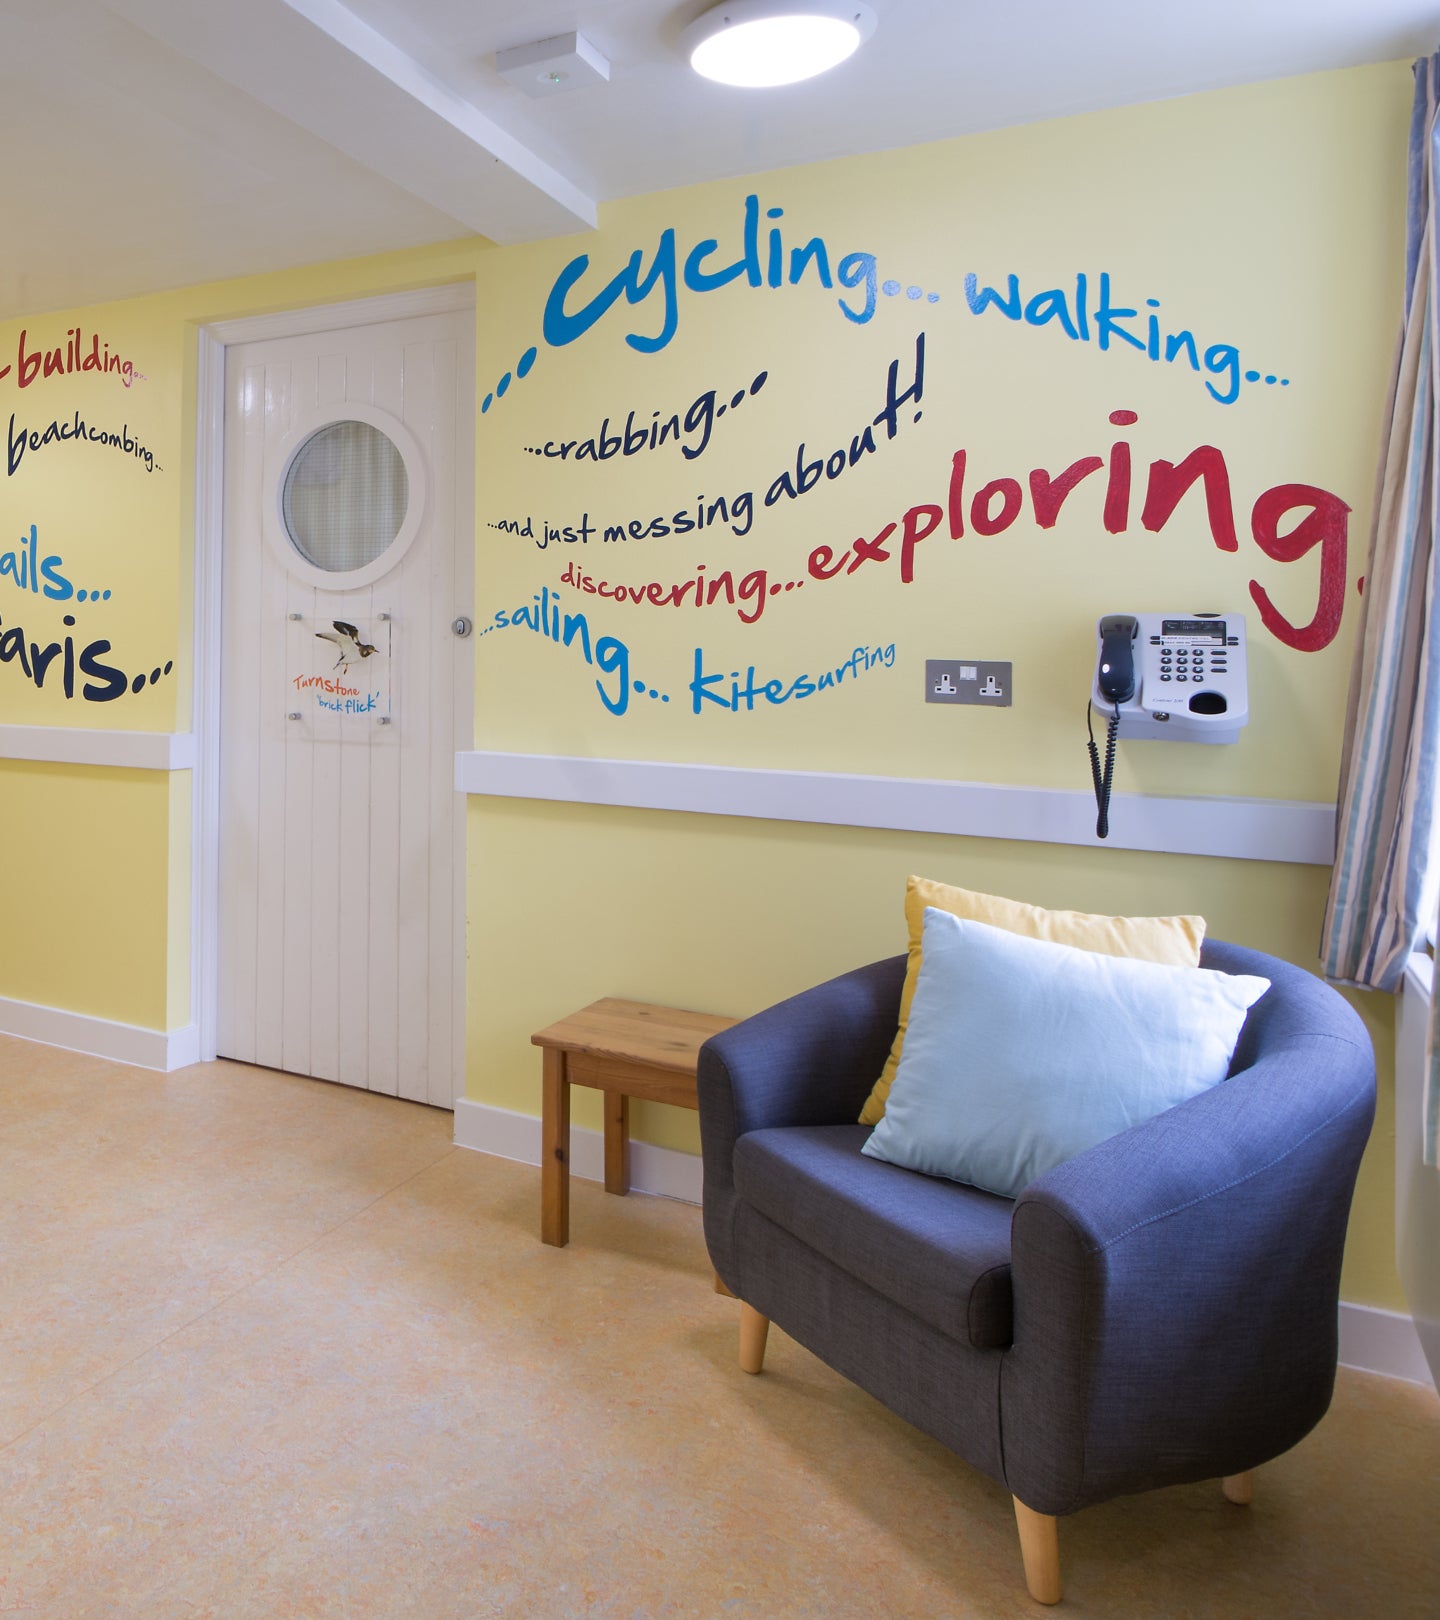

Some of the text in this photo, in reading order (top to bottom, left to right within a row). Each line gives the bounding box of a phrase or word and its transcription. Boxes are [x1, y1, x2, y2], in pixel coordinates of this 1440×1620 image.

[536, 513, 596, 549] just
[604, 492, 753, 542] messing
[764, 332, 925, 507] about!
[293, 674, 360, 696] Turnstone
[689, 644, 895, 714] kitesurfing
